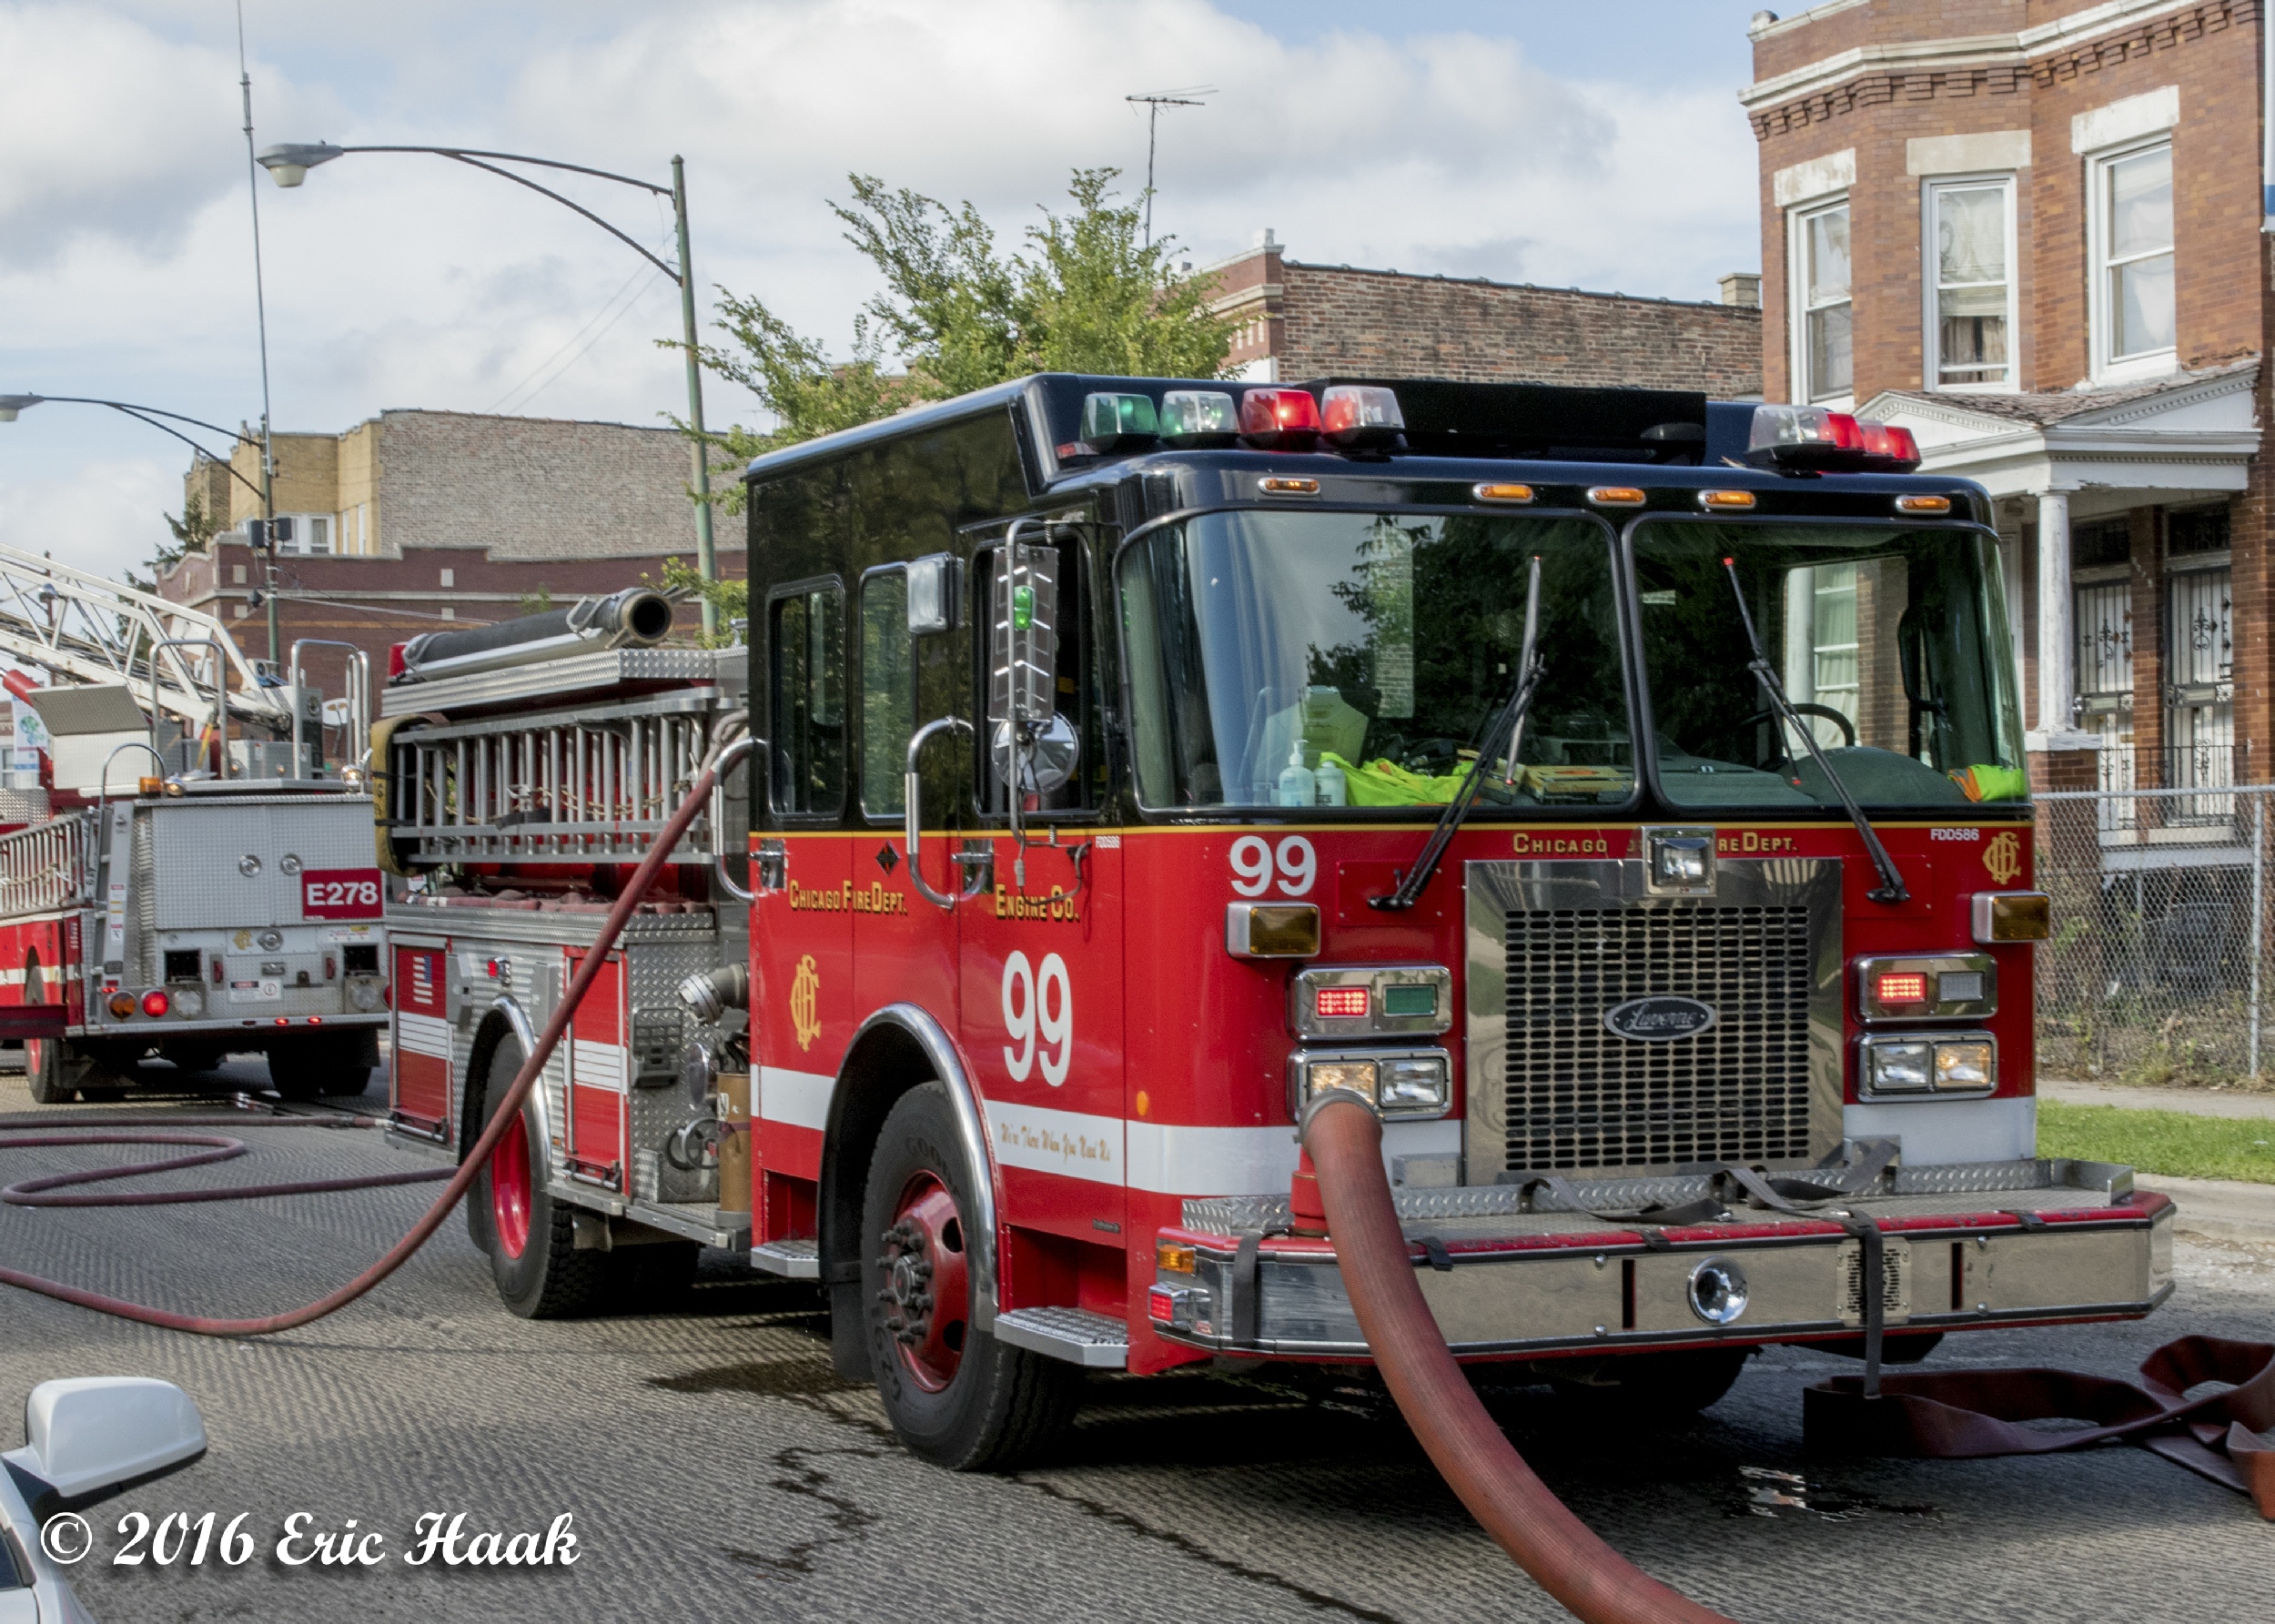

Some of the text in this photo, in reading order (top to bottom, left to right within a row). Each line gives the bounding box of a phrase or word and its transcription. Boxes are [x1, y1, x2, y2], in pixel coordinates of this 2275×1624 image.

[1930, 828, 1980, 841] FDD586
[1229, 835, 1317, 896] 99
[307, 882, 379, 906] E278
[1002, 950, 1072, 1087] 99
